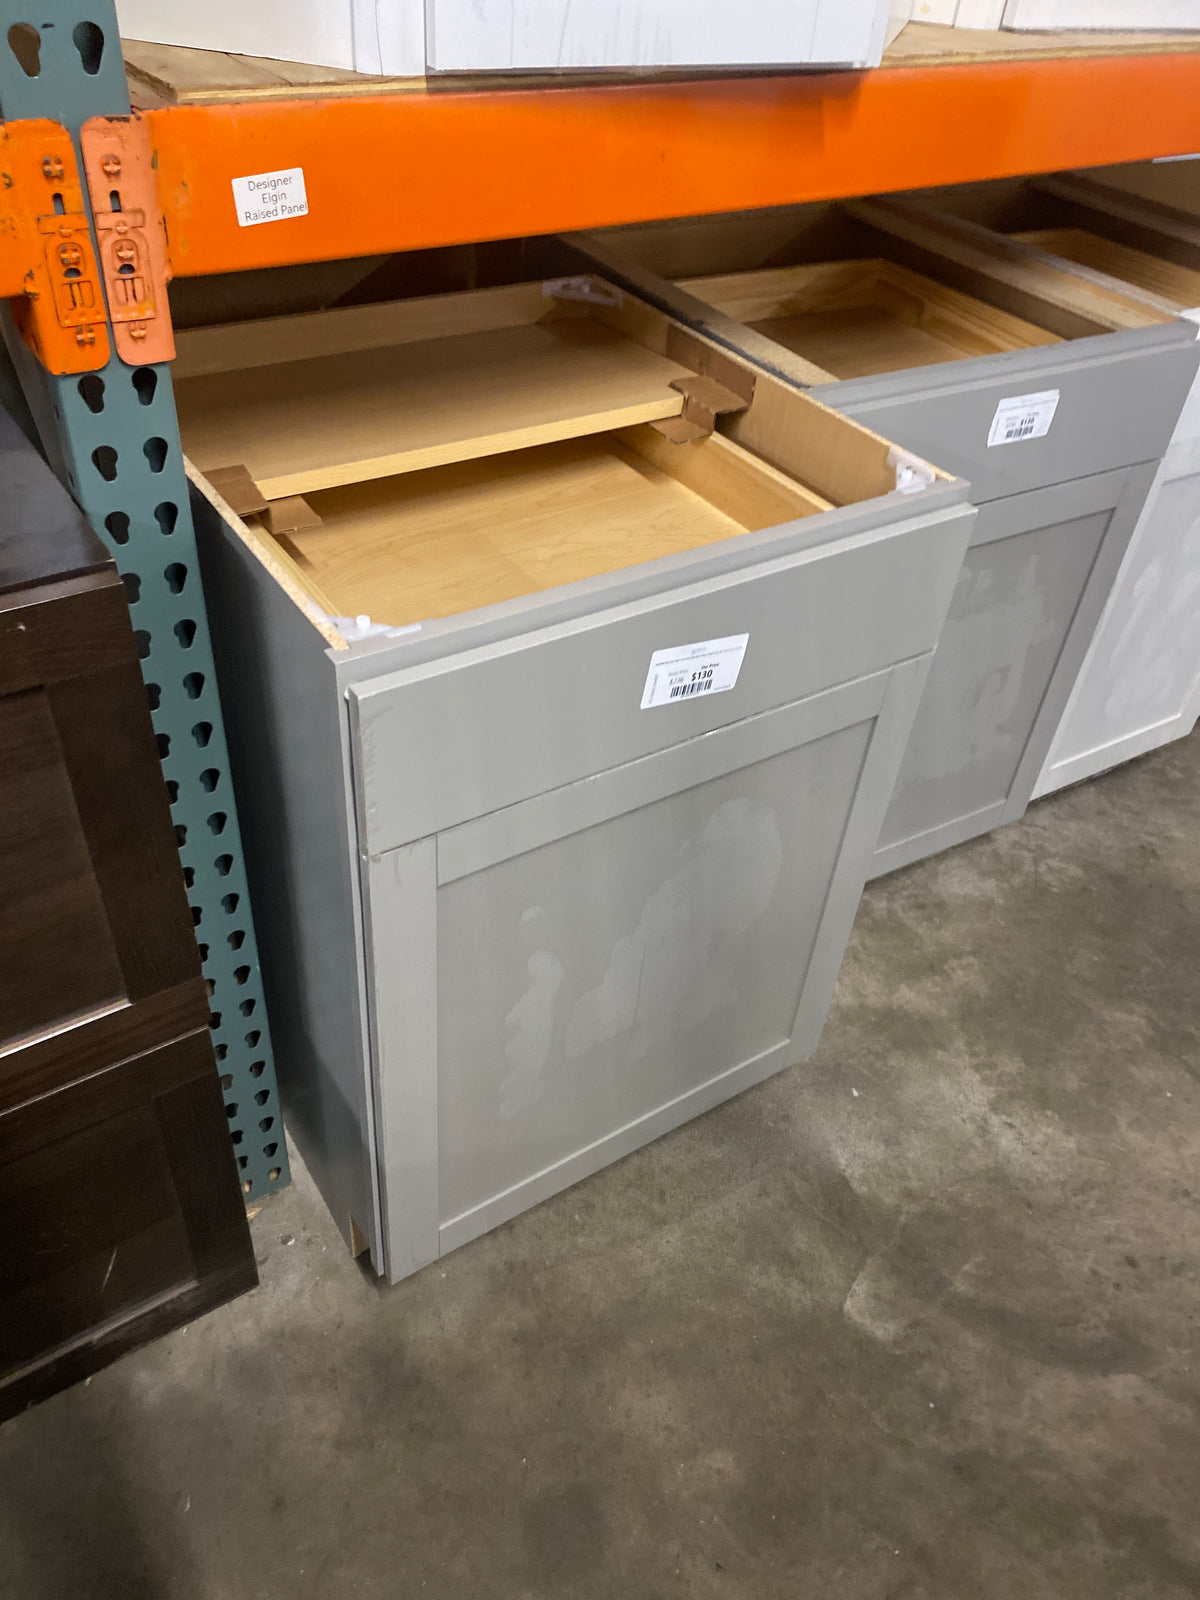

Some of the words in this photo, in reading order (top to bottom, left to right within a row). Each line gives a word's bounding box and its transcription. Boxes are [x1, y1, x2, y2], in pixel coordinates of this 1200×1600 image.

[248, 176, 293, 191] Designer
[261, 191, 287, 205] Elgin
[245, 207, 278, 221] Raised
[280, 201, 308, 215] Panel
[691, 670, 713, 681] $130
